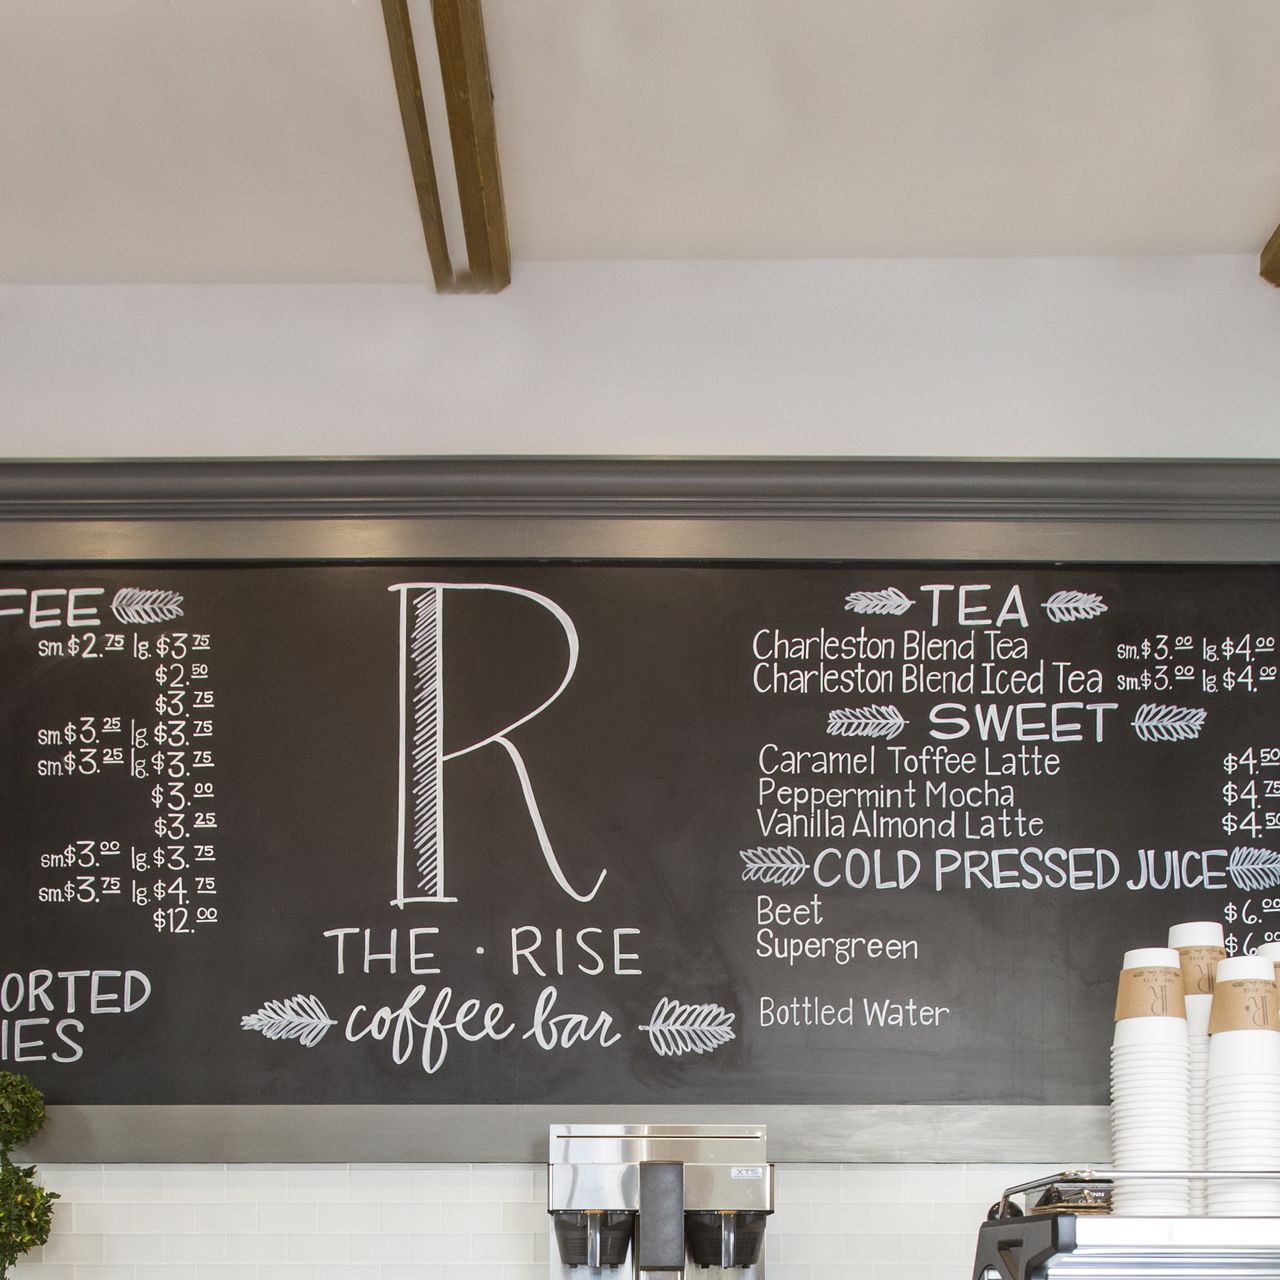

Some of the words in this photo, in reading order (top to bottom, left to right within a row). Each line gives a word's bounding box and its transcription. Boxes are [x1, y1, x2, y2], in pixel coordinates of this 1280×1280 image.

[920, 584, 1029, 628] TEA
[753, 626, 895, 659] Charleston
[904, 630, 975, 660] Blend
[984, 630, 1028, 660] Tea
[753, 662, 893, 693] Charleston
[902, 664, 974, 694] Blend
[981, 659, 1044, 694] Iced
[1052, 662, 1102, 693] Tea
[929, 702, 1118, 742] SWEET
[388, 582, 607, 910] R
[759, 744, 875, 774] Caramel
[887, 746, 976, 774] Toffee
[985, 745, 1060, 776] Latte
[759, 777, 916, 817] Peppermint
[926, 779, 1014, 808] Mocha
[757, 808, 844, 838] Vanilla
[852, 810, 955, 838] Almond
[966, 809, 1043, 839] Latte
[814, 848, 920, 889] COLD
[936, 847, 1120, 891] PRESSED
[1126, 849, 1228, 890] JUICE
[758, 894, 823, 925] Beet
[323, 927, 440, 974] THE
[511, 926, 642, 976] RISE
[757, 928, 917, 966] Supergreen
[761, 997, 852, 1026] Bottled
[863, 998, 949, 1026] Water
[1149, 985, 1168, 1016] R
[1248, 996, 1269, 1028] R
[345, 985, 515, 1074] coffee
[522, 986, 621, 1050] bar
[736, 1168, 759, 1176] XTS
